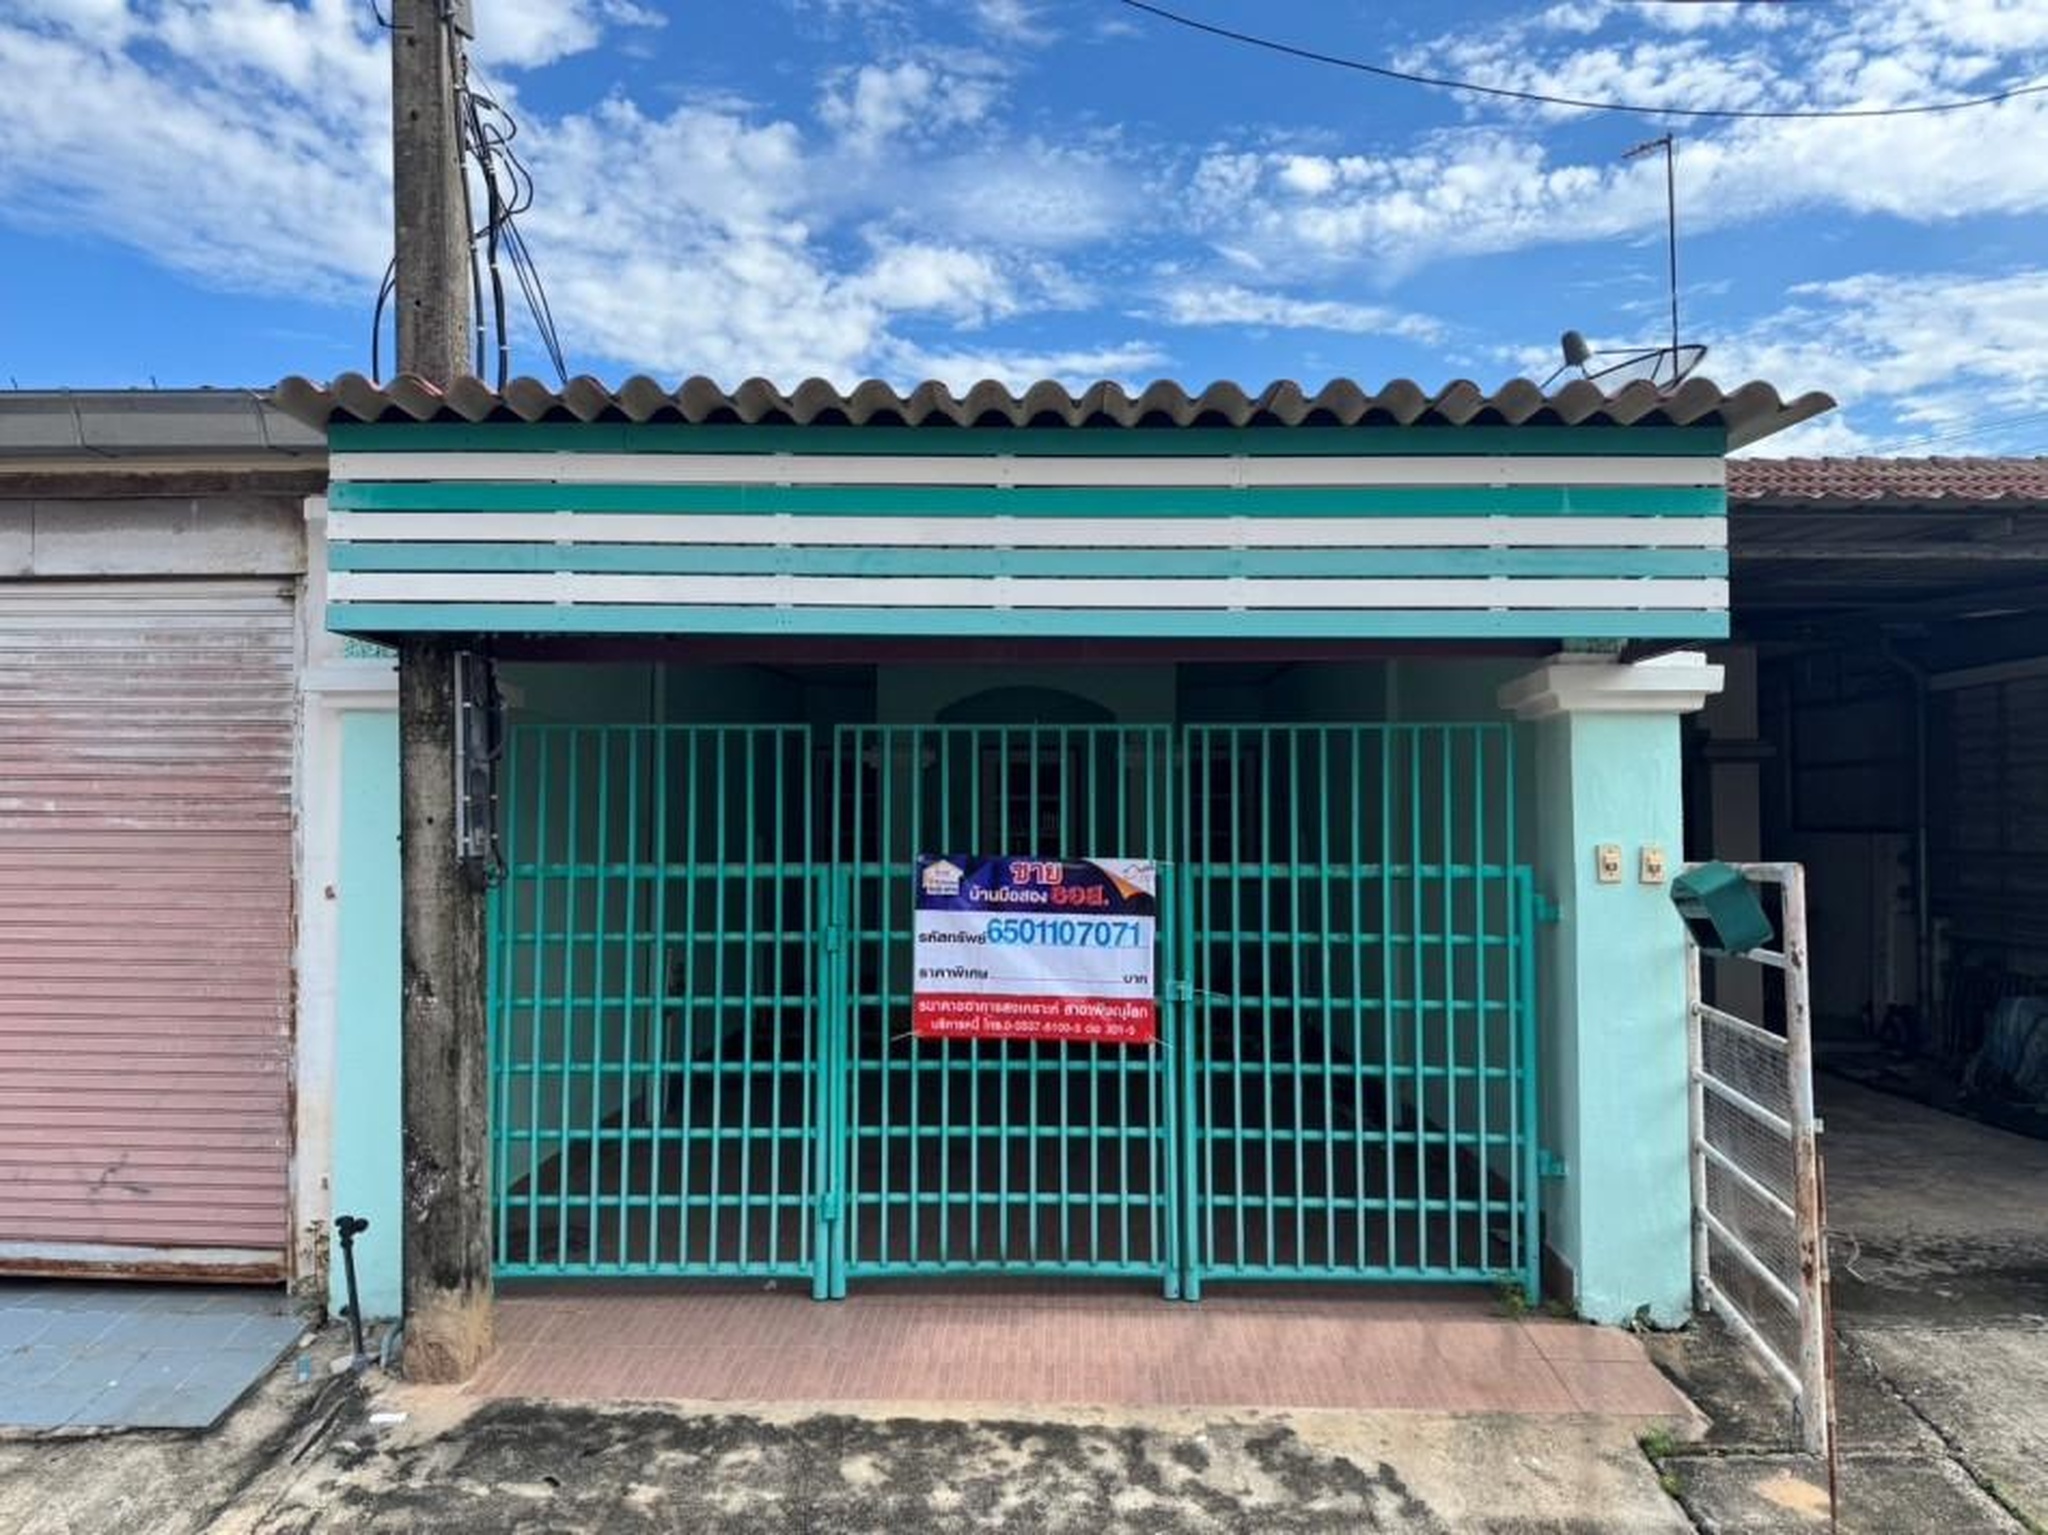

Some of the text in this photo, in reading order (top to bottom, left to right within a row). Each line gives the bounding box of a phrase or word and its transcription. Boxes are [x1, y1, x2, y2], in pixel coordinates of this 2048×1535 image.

[1010, 861, 1063, 885] ขาย
[969, 884, 1110, 907] บ้านมือสอง ธอส.
[918, 918, 1140, 947] รหัสทรัพย์ 6501107071
[919, 964, 1148, 985] ราคาพิเศษ บาท
[918, 1000, 1059, 1016] ธนาคารอาคารสงเคราะห์
